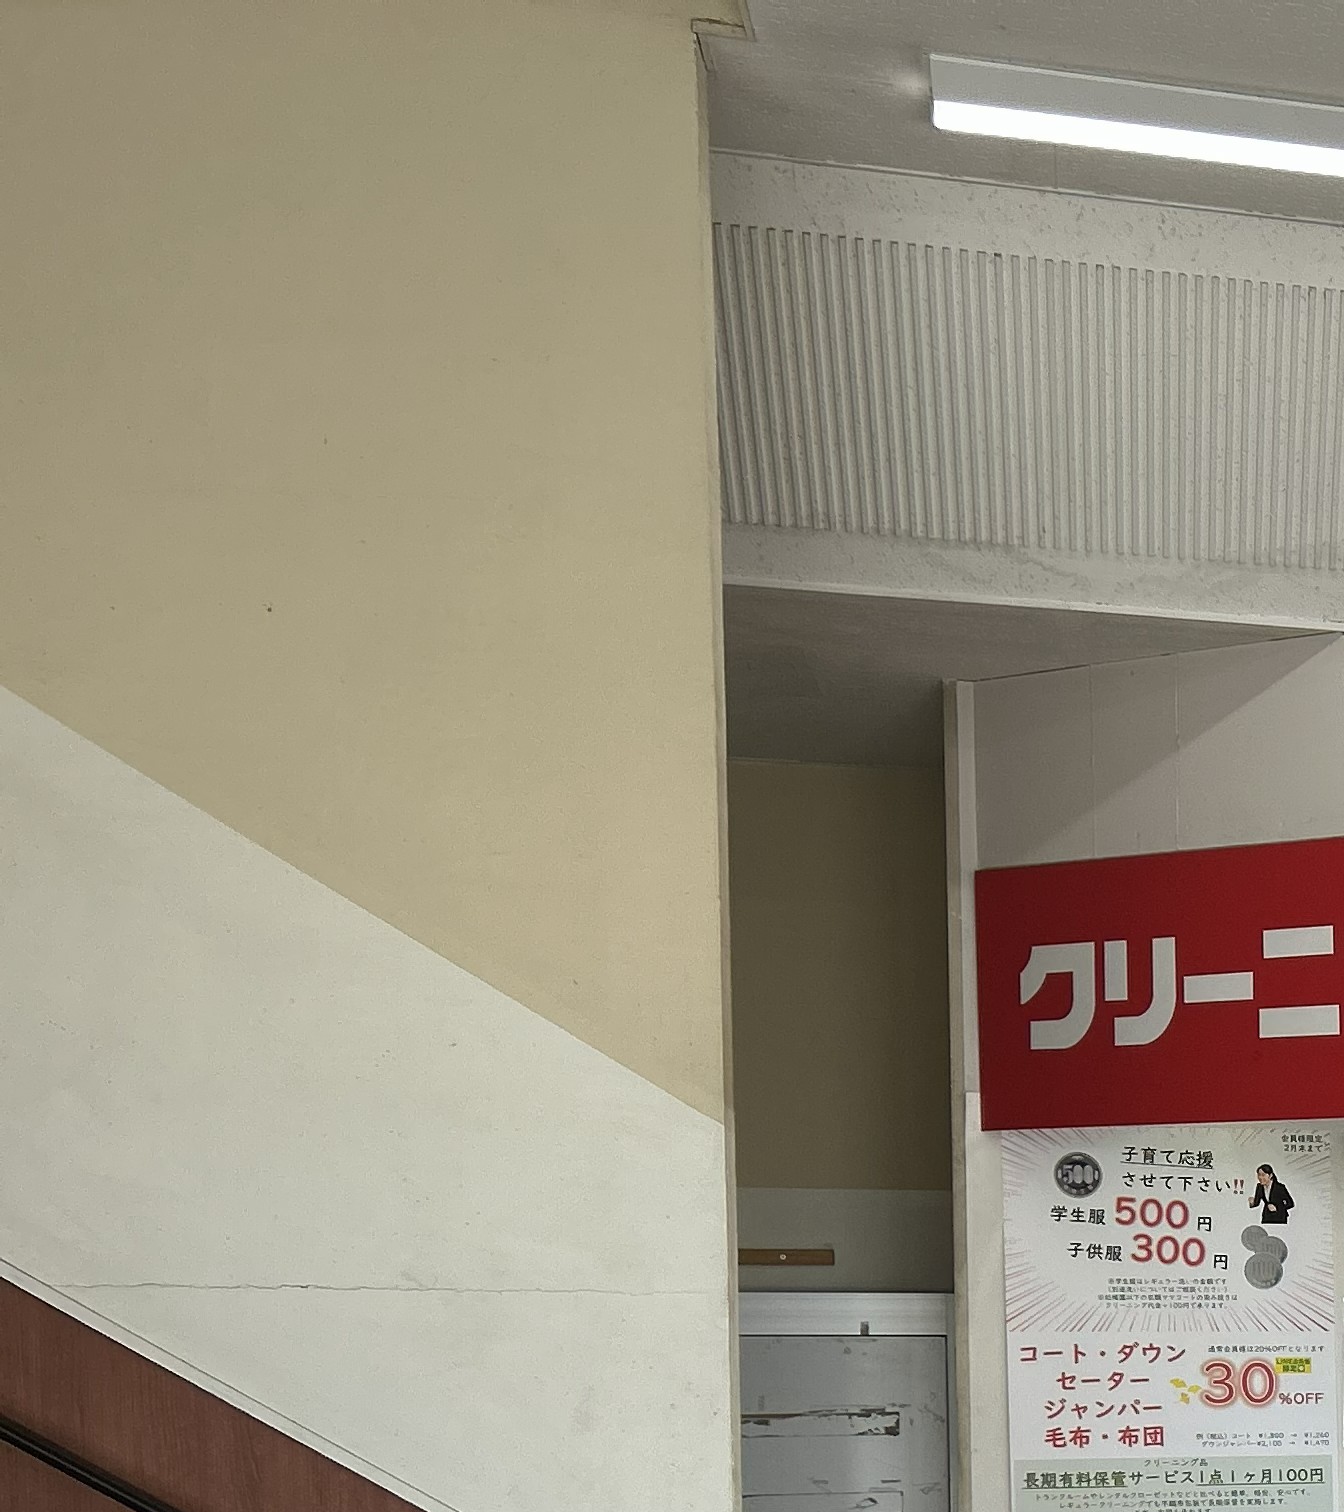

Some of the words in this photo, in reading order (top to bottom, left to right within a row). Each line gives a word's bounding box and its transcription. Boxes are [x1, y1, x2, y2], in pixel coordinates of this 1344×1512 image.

[1122, 1146, 1214, 1168] 子育て応援
[1050, 1205, 1106, 1225] 学生服
[1115, 1196, 1190, 1229] 500
[1197, 1216, 1212, 1232] 円
[1067, 1242, 1122, 1262] 子供服
[1131, 1233, 1206, 1266] 300
[1214, 1254, 1228, 1270] 円
[1020, 1344, 1186, 1364] コート・ダウン
[1056, 1372, 1150, 1391] セーター
[1204, 1361, 1276, 1405] 30
[1279, 1392, 1324, 1404] %OFF
[1044, 1400, 1163, 1419] ジャンパー
[1044, 1425, 1164, 1448] 毛布・布団
